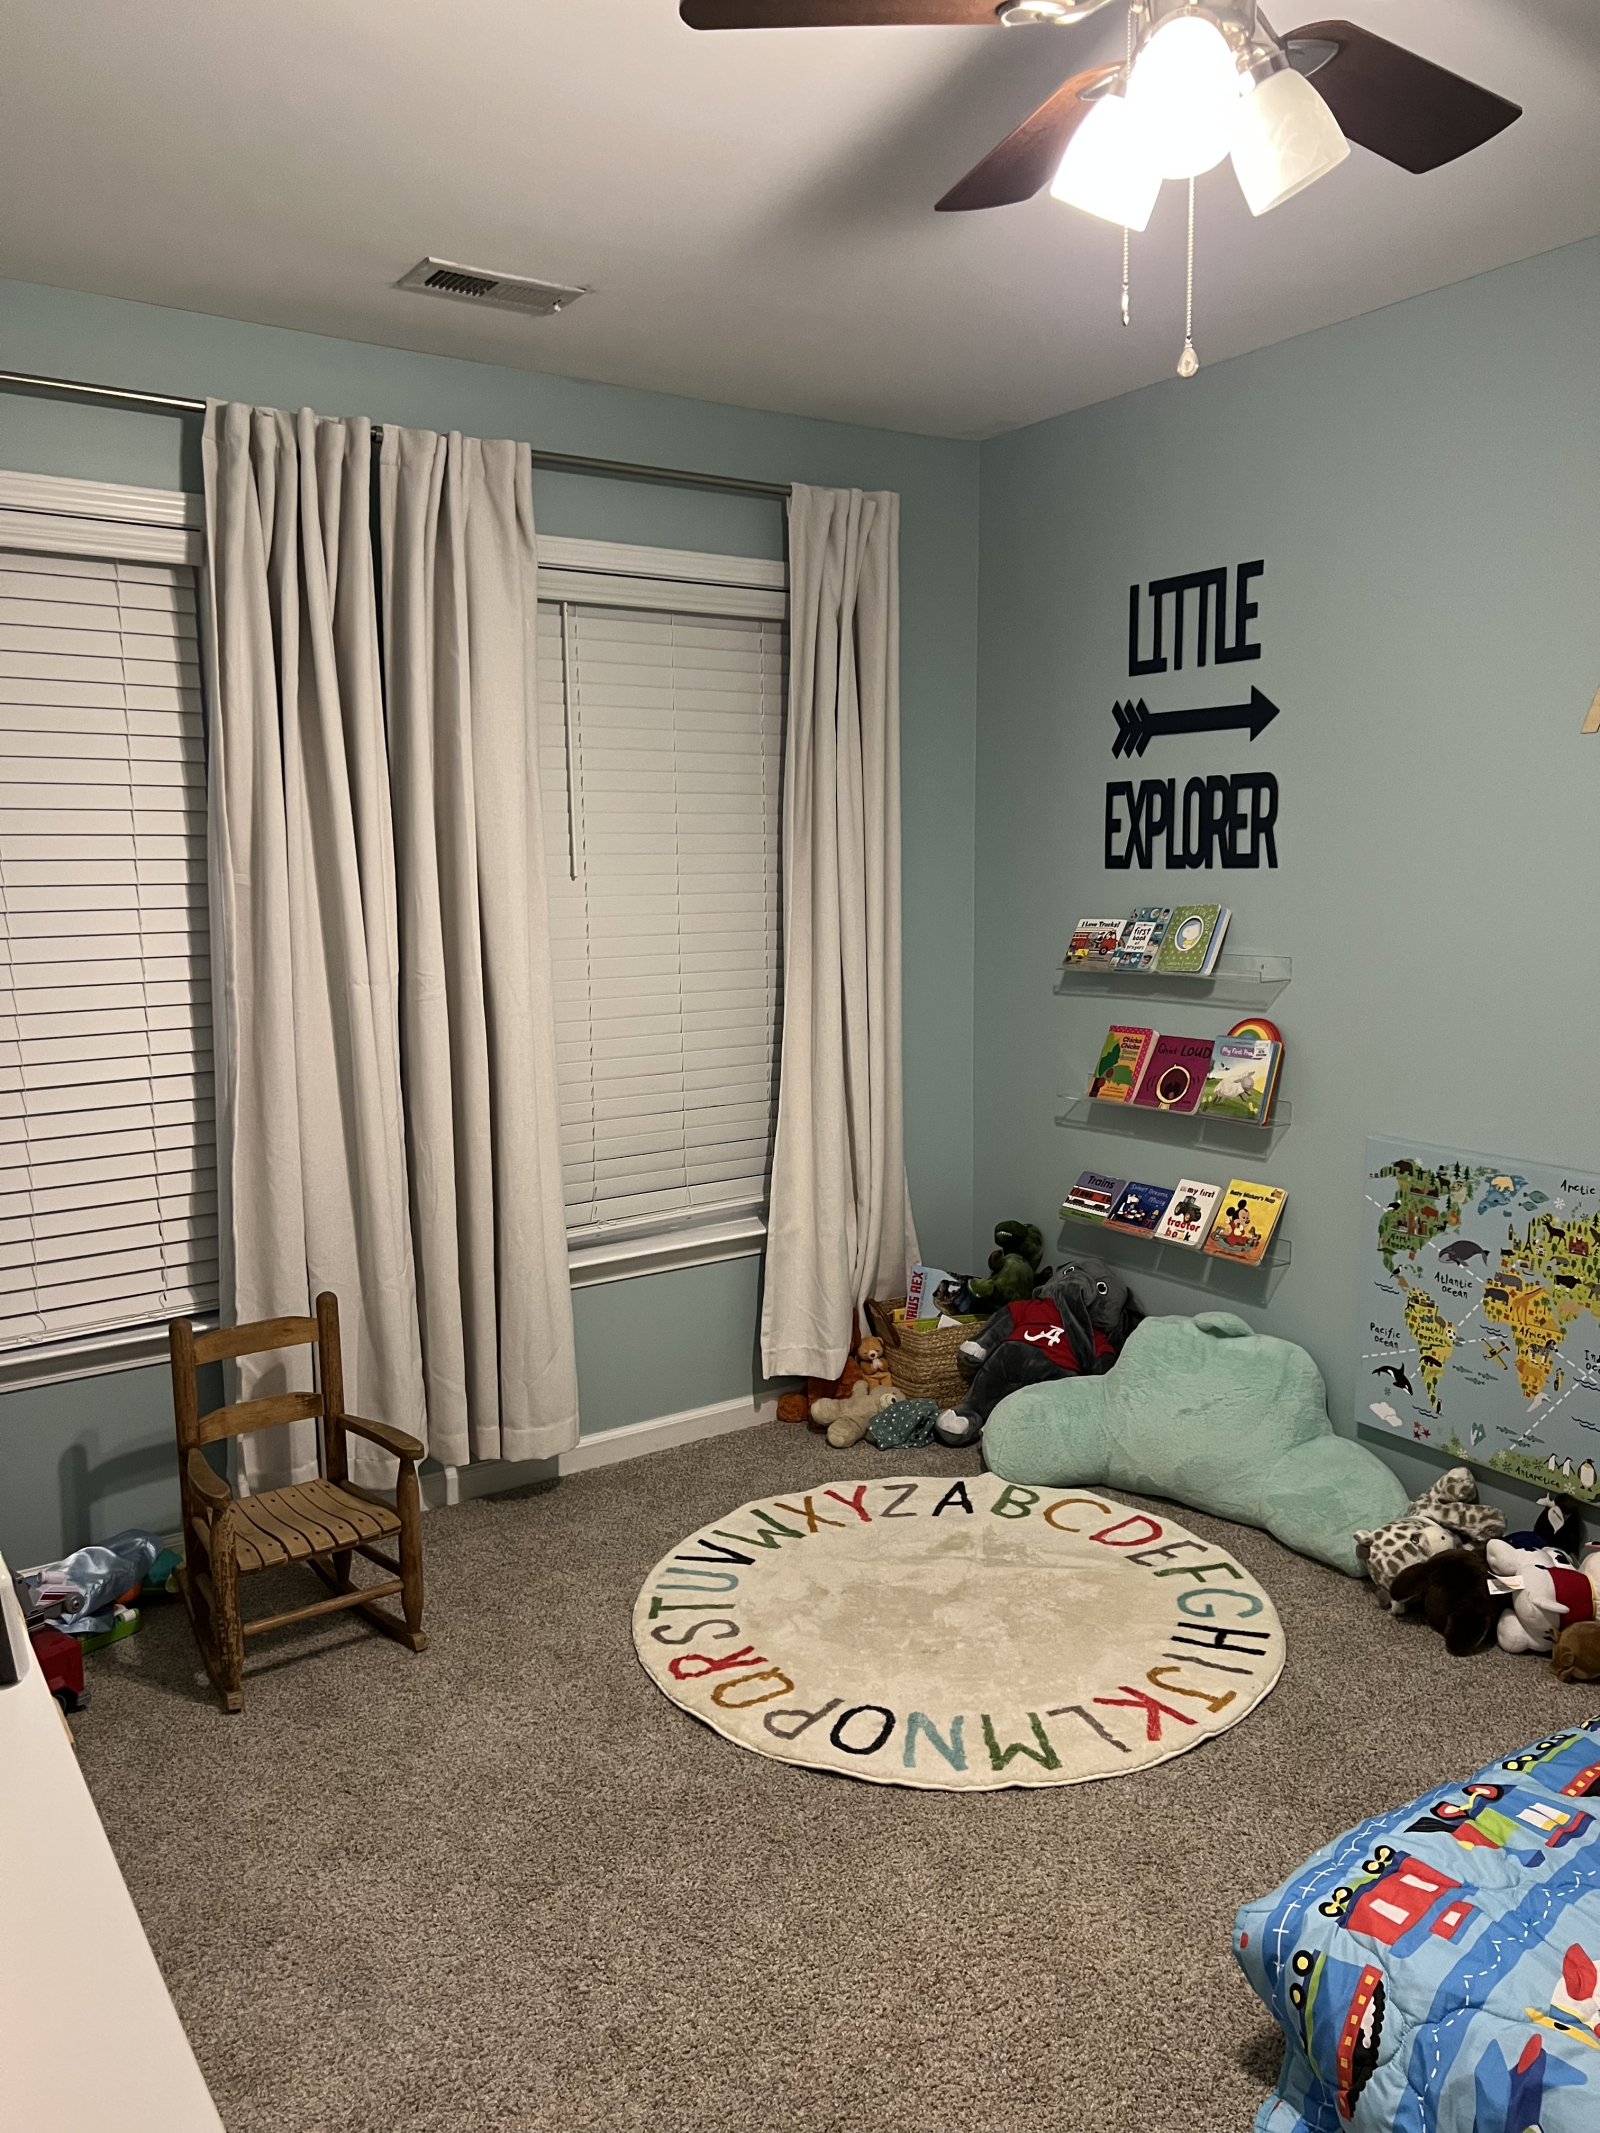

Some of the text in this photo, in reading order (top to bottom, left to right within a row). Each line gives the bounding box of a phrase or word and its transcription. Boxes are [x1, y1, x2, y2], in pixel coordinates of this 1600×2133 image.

[1128, 559, 1265, 677] LITTLE
[1104, 772, 1279, 870] EXPLORER
[1134, 926, 1151, 936] first
[1158, 1043, 1213, 1059] Quiet LOUD
[1087, 1175, 1116, 1189] Trains
[1560, 1179, 1596, 1195] Arctic
[1187, 1187, 1198, 1196] my
[1200, 1189, 1216, 1199] first
[1167, 1216, 1201, 1232] tractor
[1165, 1227, 1191, 1241] book
[909, 1270, 924, 1294] REX
[1434, 1271, 1473, 1289] Atlantic
[1370, 1322, 1401, 1339] Pacific
[1519, 1326, 1547, 1341] Africa
[1515, 1465, 1560, 1489] Antarctica
